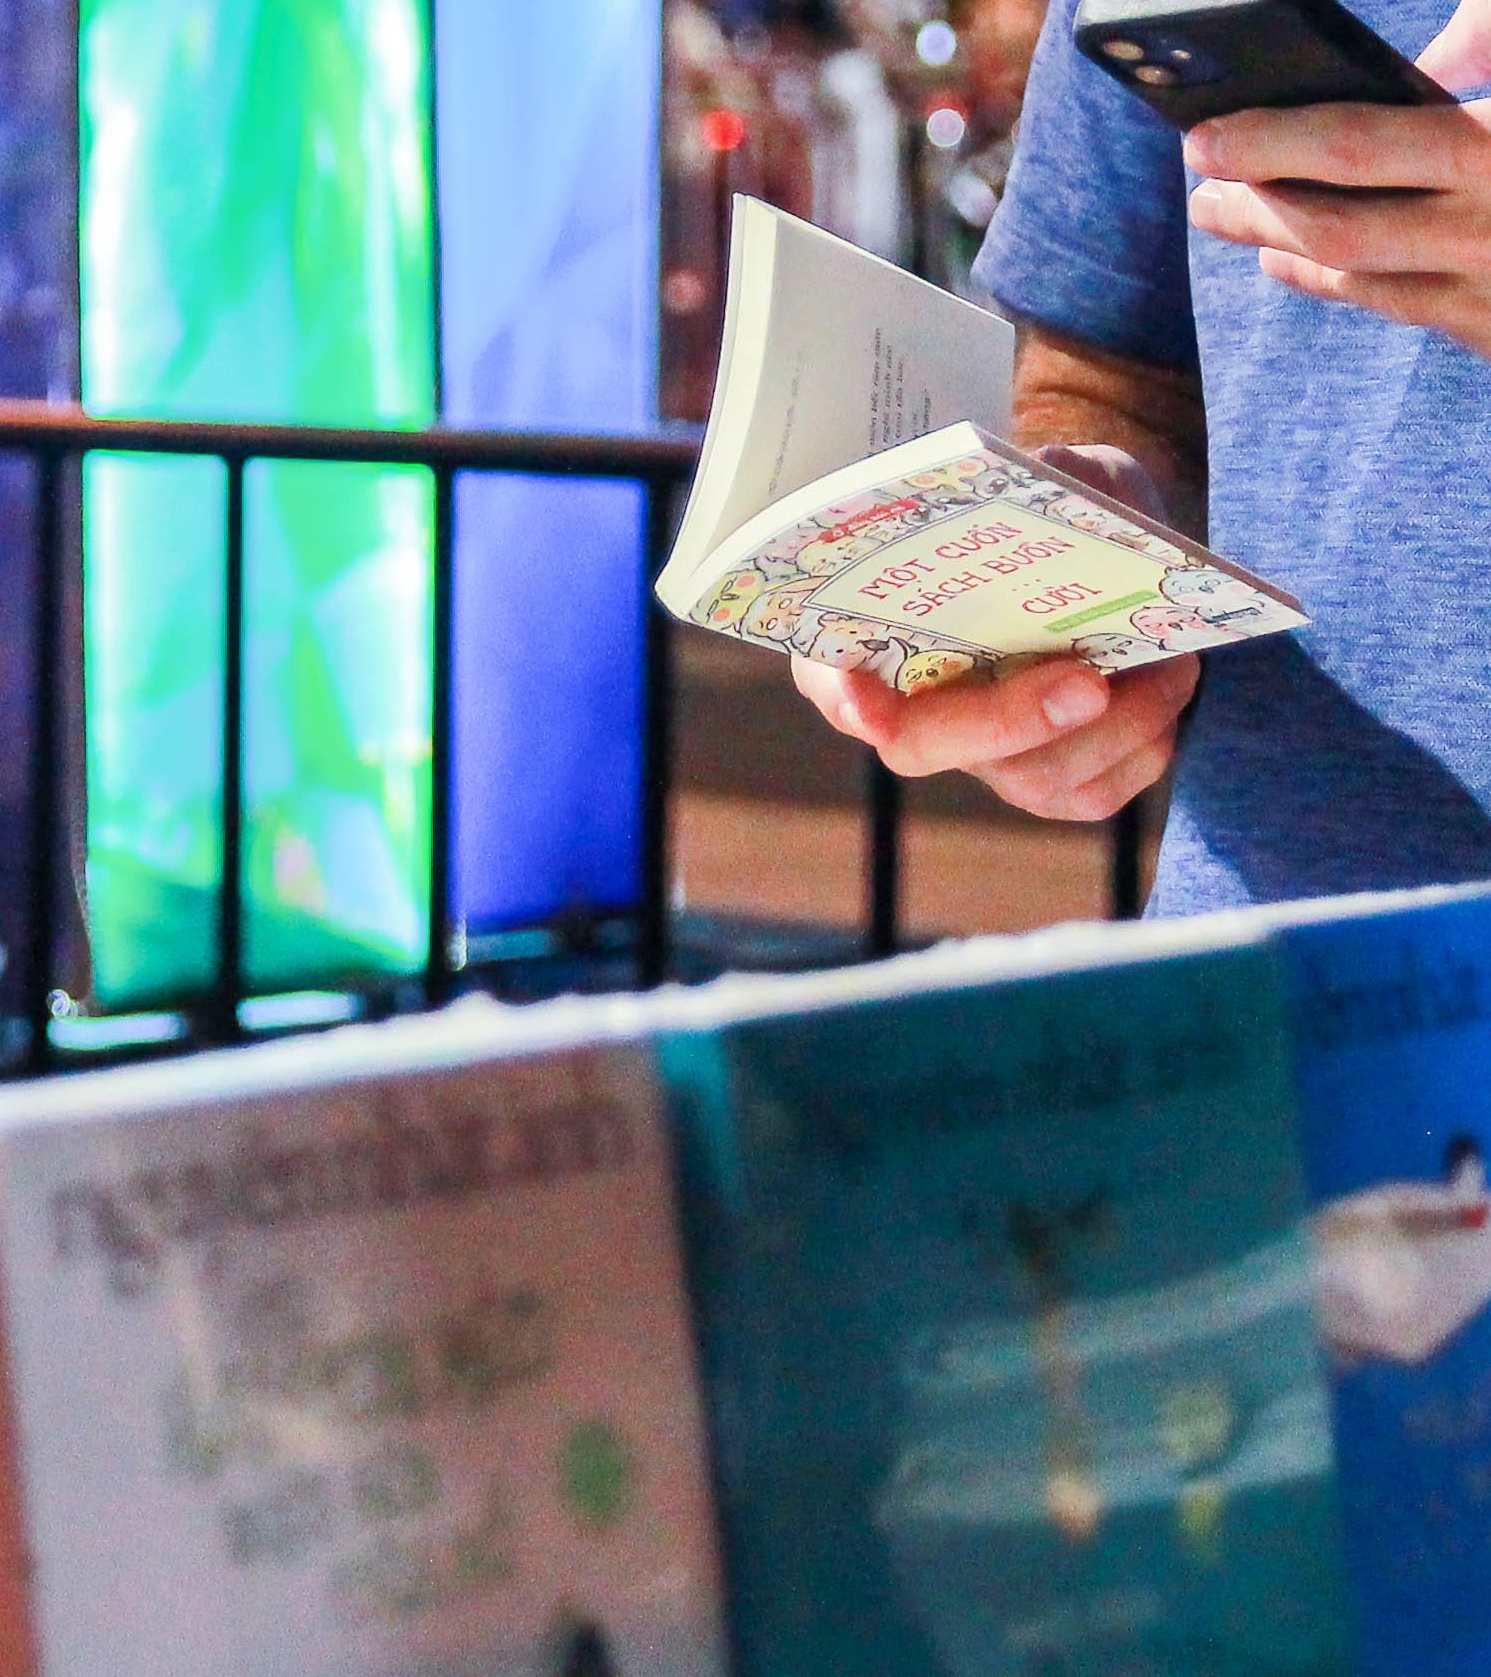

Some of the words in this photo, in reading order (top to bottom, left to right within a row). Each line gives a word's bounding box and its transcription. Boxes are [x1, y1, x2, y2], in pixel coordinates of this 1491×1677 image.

[858, 558, 936, 600] MỘT
[935, 521, 1023, 560] CUỐN
[902, 571, 993, 616] SÁCH
